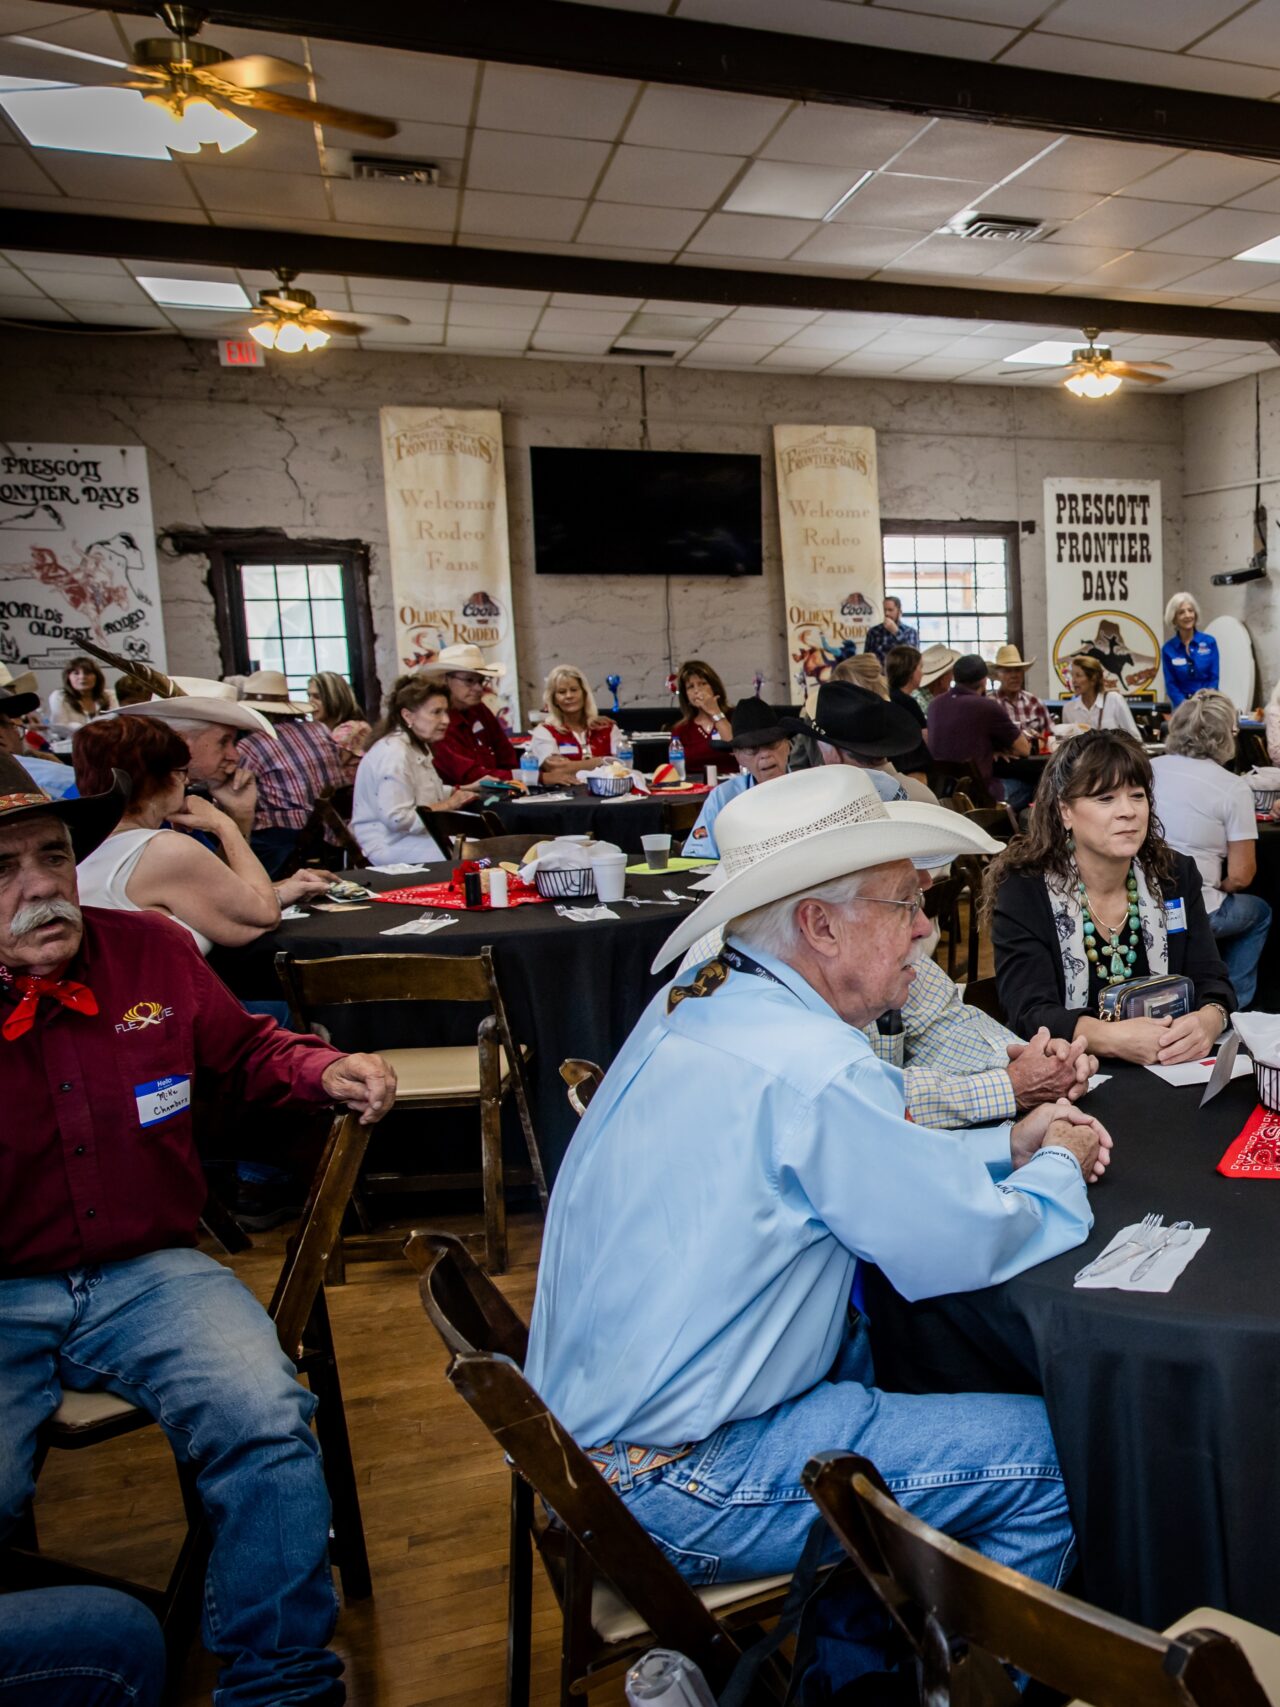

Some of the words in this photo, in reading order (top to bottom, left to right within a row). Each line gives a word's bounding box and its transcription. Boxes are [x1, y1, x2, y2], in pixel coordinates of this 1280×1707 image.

[226, 340, 257, 364] EXIT
[2, 457, 102, 483] PRESCOTT
[82, 486, 140, 510] DAYS
[399, 489, 496, 511] Welcome
[788, 500, 870, 519] Welcome
[1055, 493, 1150, 526] PRESCOTT
[416, 520, 486, 541] Rodeo
[802, 528, 861, 547] Rodeo
[1056, 532, 1152, 563] FRONTIER
[426, 552, 480, 572] Fans
[810, 556, 856, 575] Fans
[1082, 570, 1128, 601] DAYS
[28, 620, 94, 642] OLDEST
[103, 608, 146, 635] RODEO
[399, 606, 455, 631] OLDEST
[789, 606, 834, 629] OLDEST
[453, 623, 499, 645] RODEO
[157, 1078, 172, 1086] Hello
[156, 1089, 178, 1101] Mike
